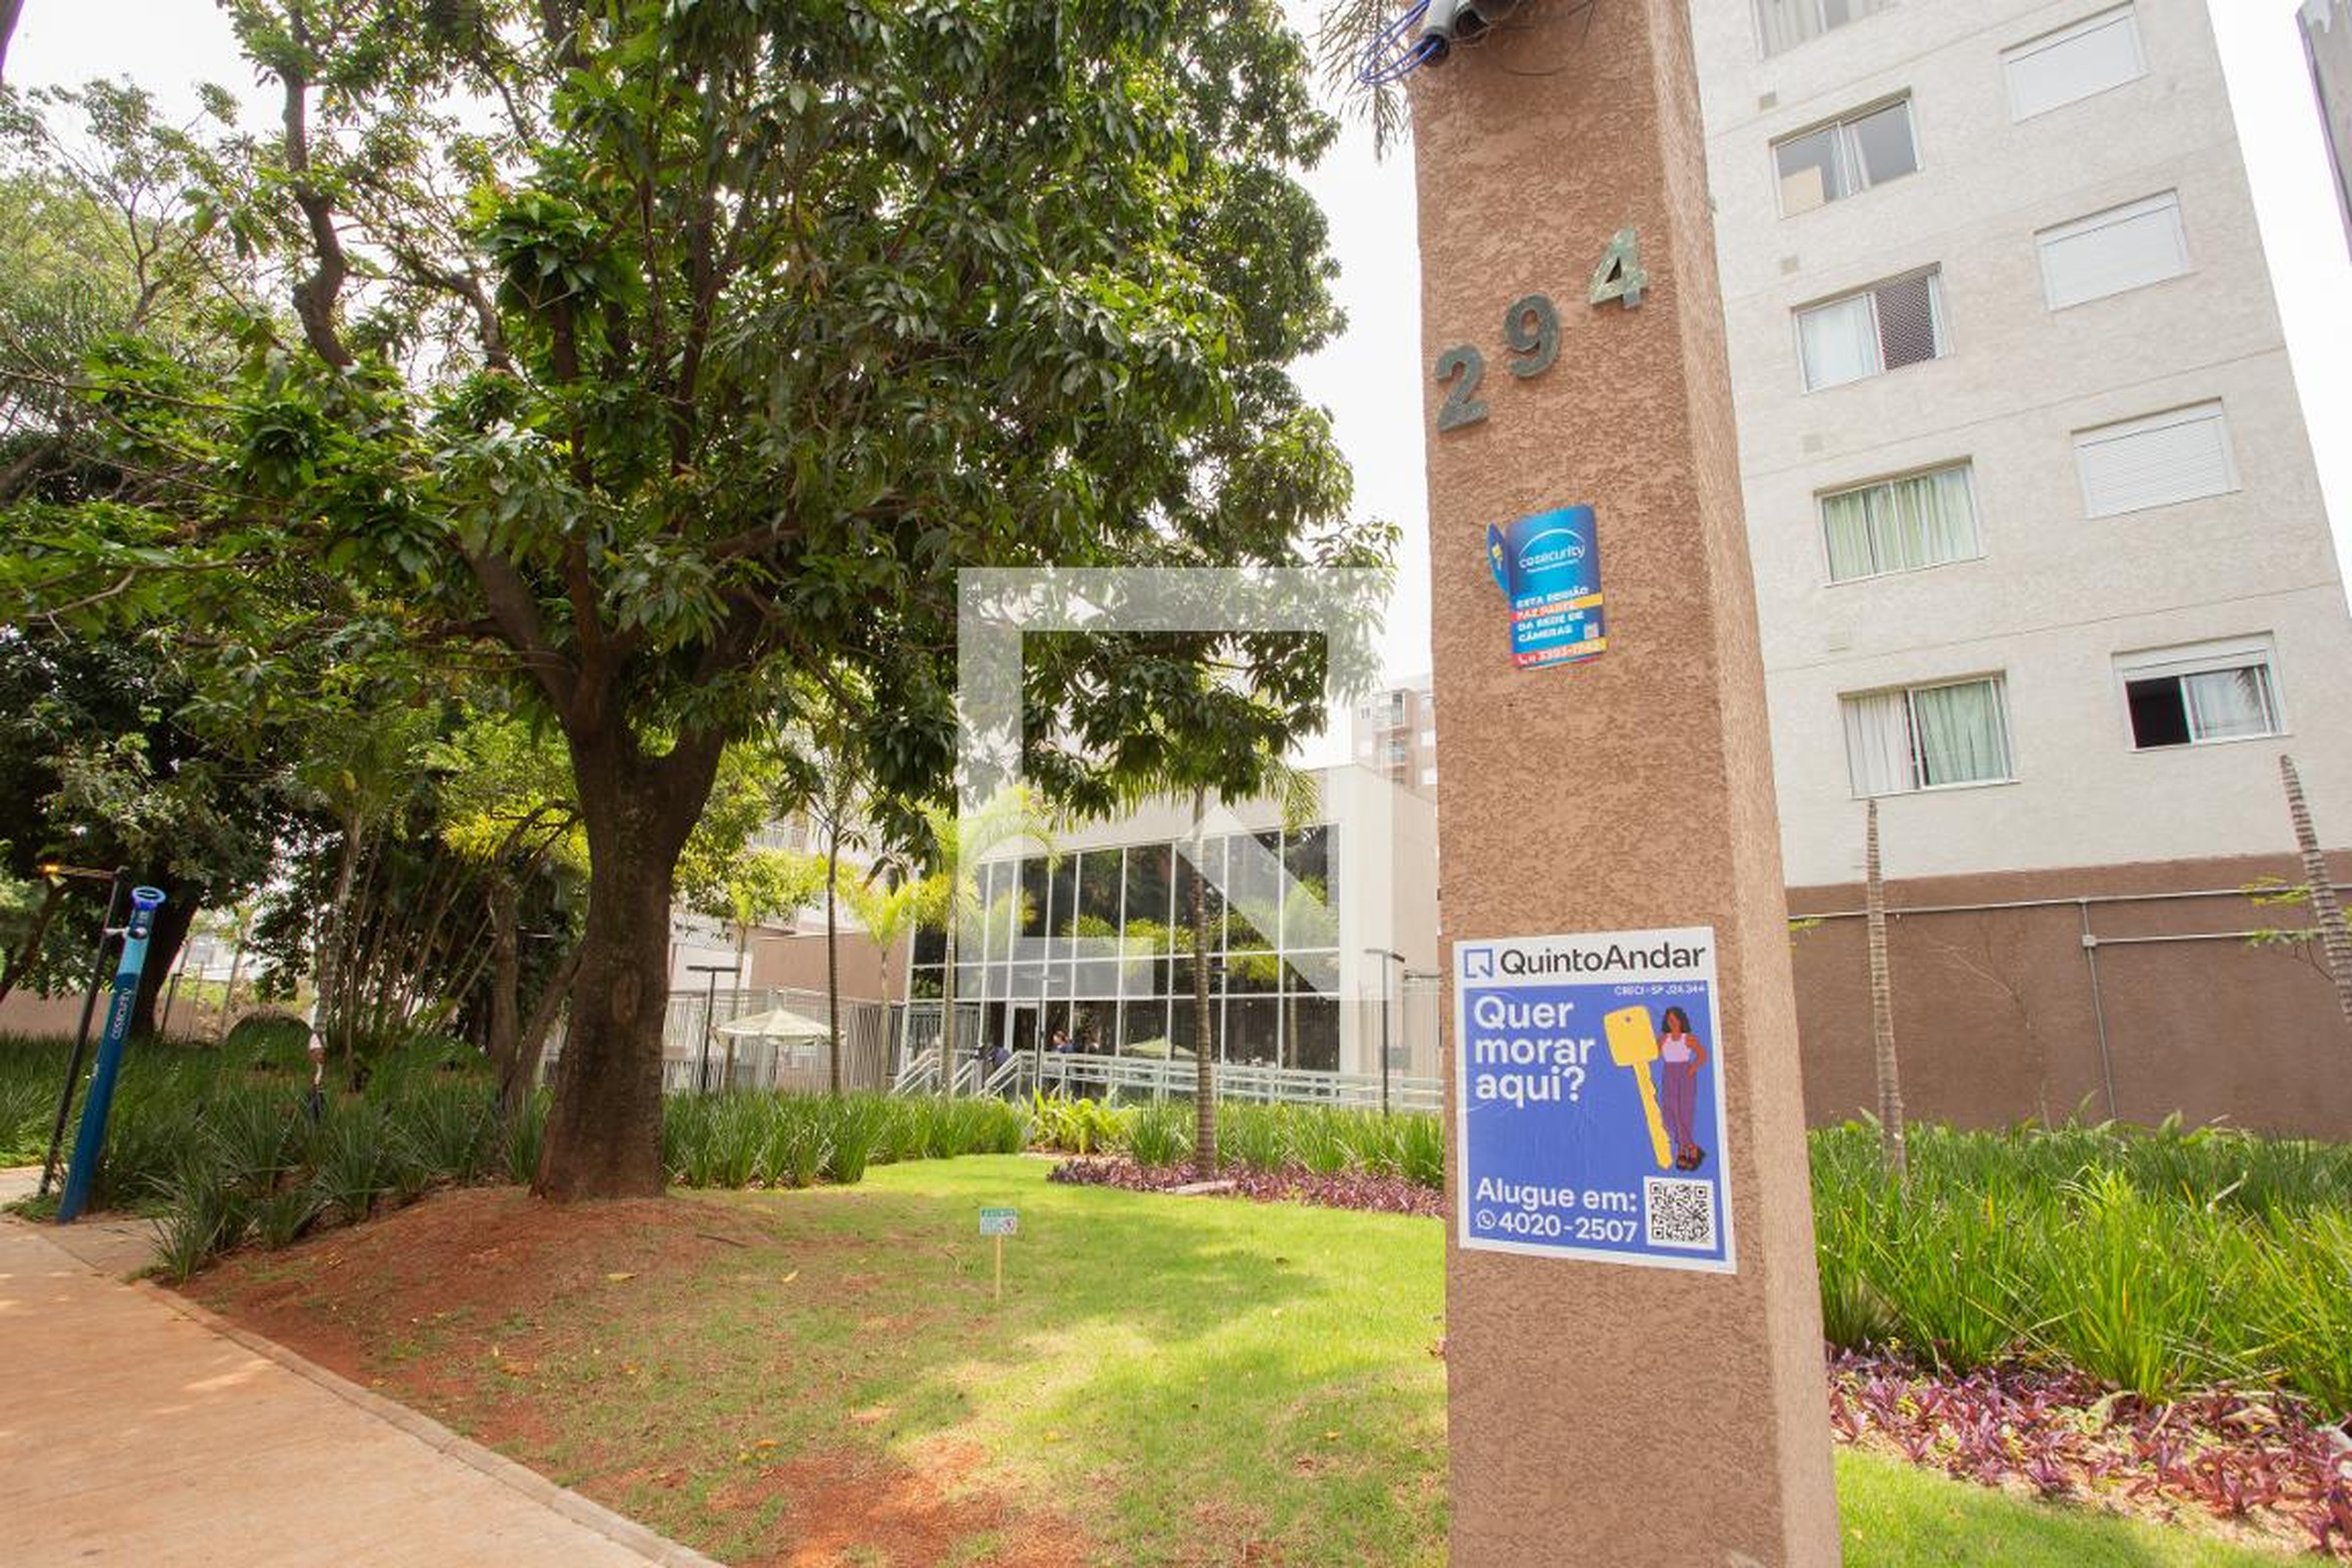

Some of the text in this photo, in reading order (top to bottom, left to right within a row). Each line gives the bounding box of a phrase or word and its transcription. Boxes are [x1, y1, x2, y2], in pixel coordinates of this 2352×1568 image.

[1437, 226, 1649, 432] 294
[1519, 544, 1585, 569] cosecurity
[1500, 942, 1706, 976] QuintoAndar
[1474, 996, 1575, 1030] Quer
[1475, 1036, 1595, 1065] morar
[1475, 1065, 1586, 1108] aqui?
[1476, 1177, 1638, 1212] Alugue em:
[1498, 1212, 1638, 1243] 4020-2507
